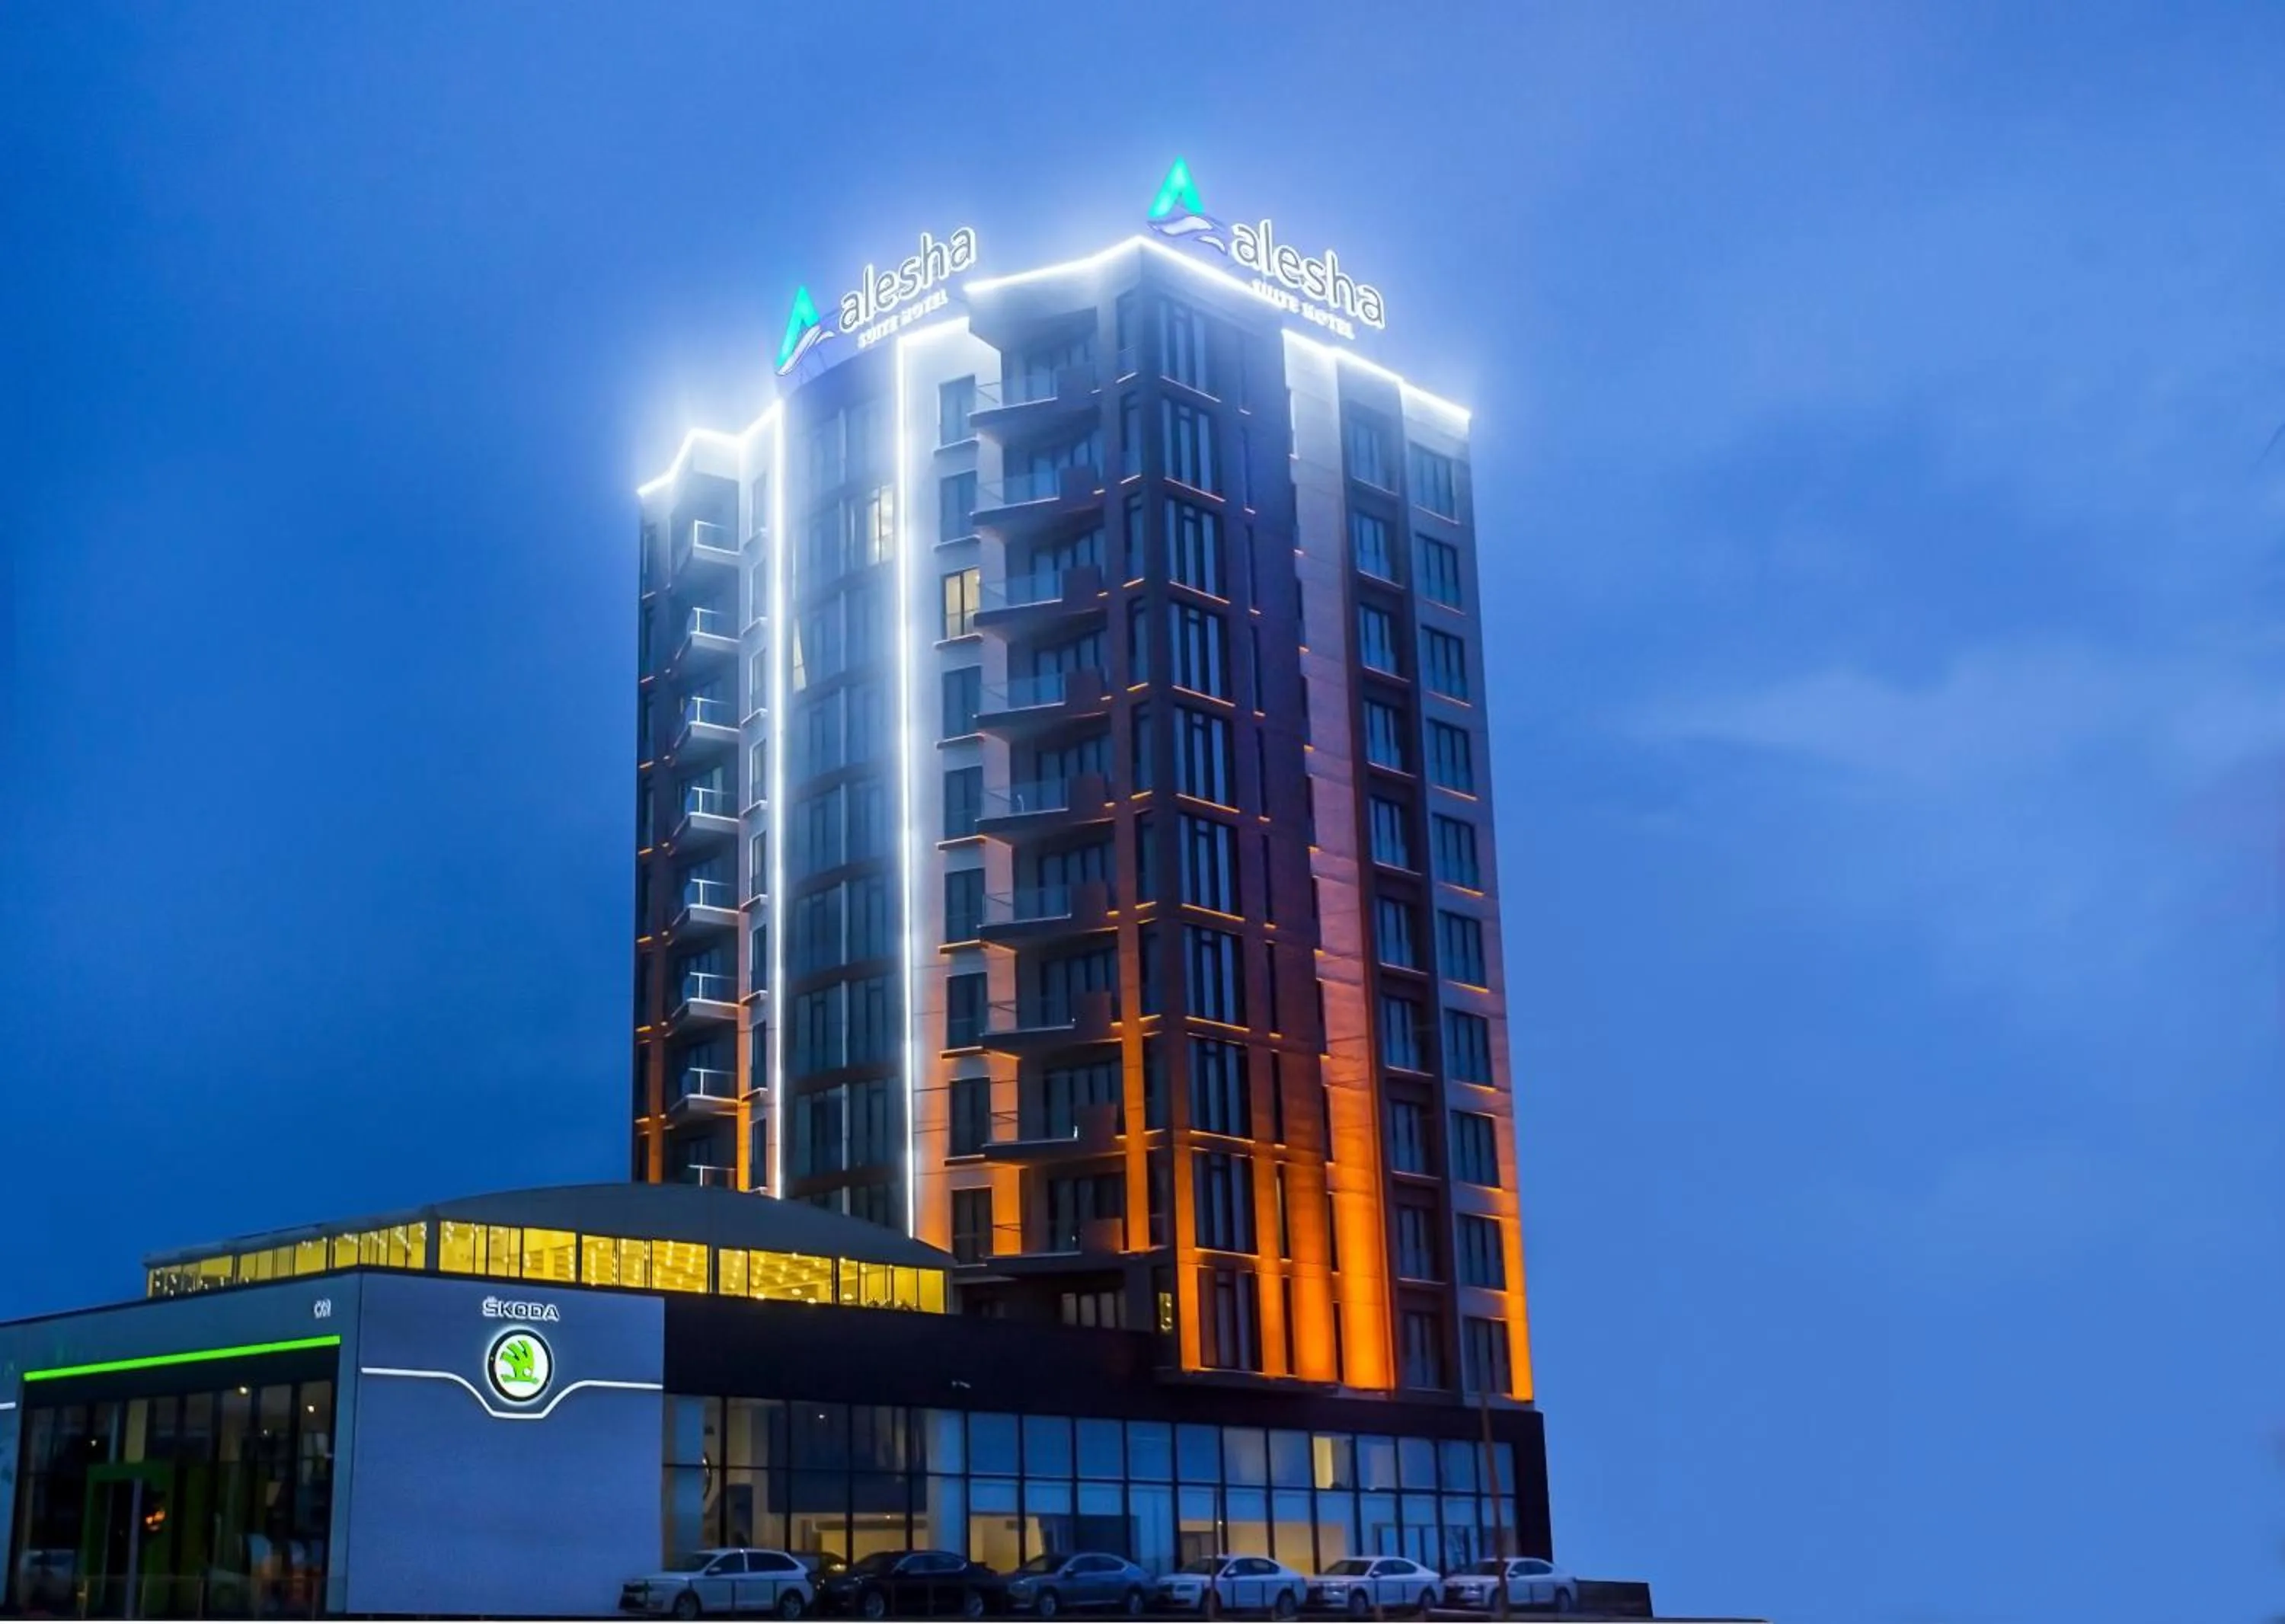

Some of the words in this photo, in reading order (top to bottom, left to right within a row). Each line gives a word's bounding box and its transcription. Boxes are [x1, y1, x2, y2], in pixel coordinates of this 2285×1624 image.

[839, 226, 976, 332] alesha
[1231, 219, 1385, 329] alesha
[482, 1296, 560, 1322] ŠKODA
